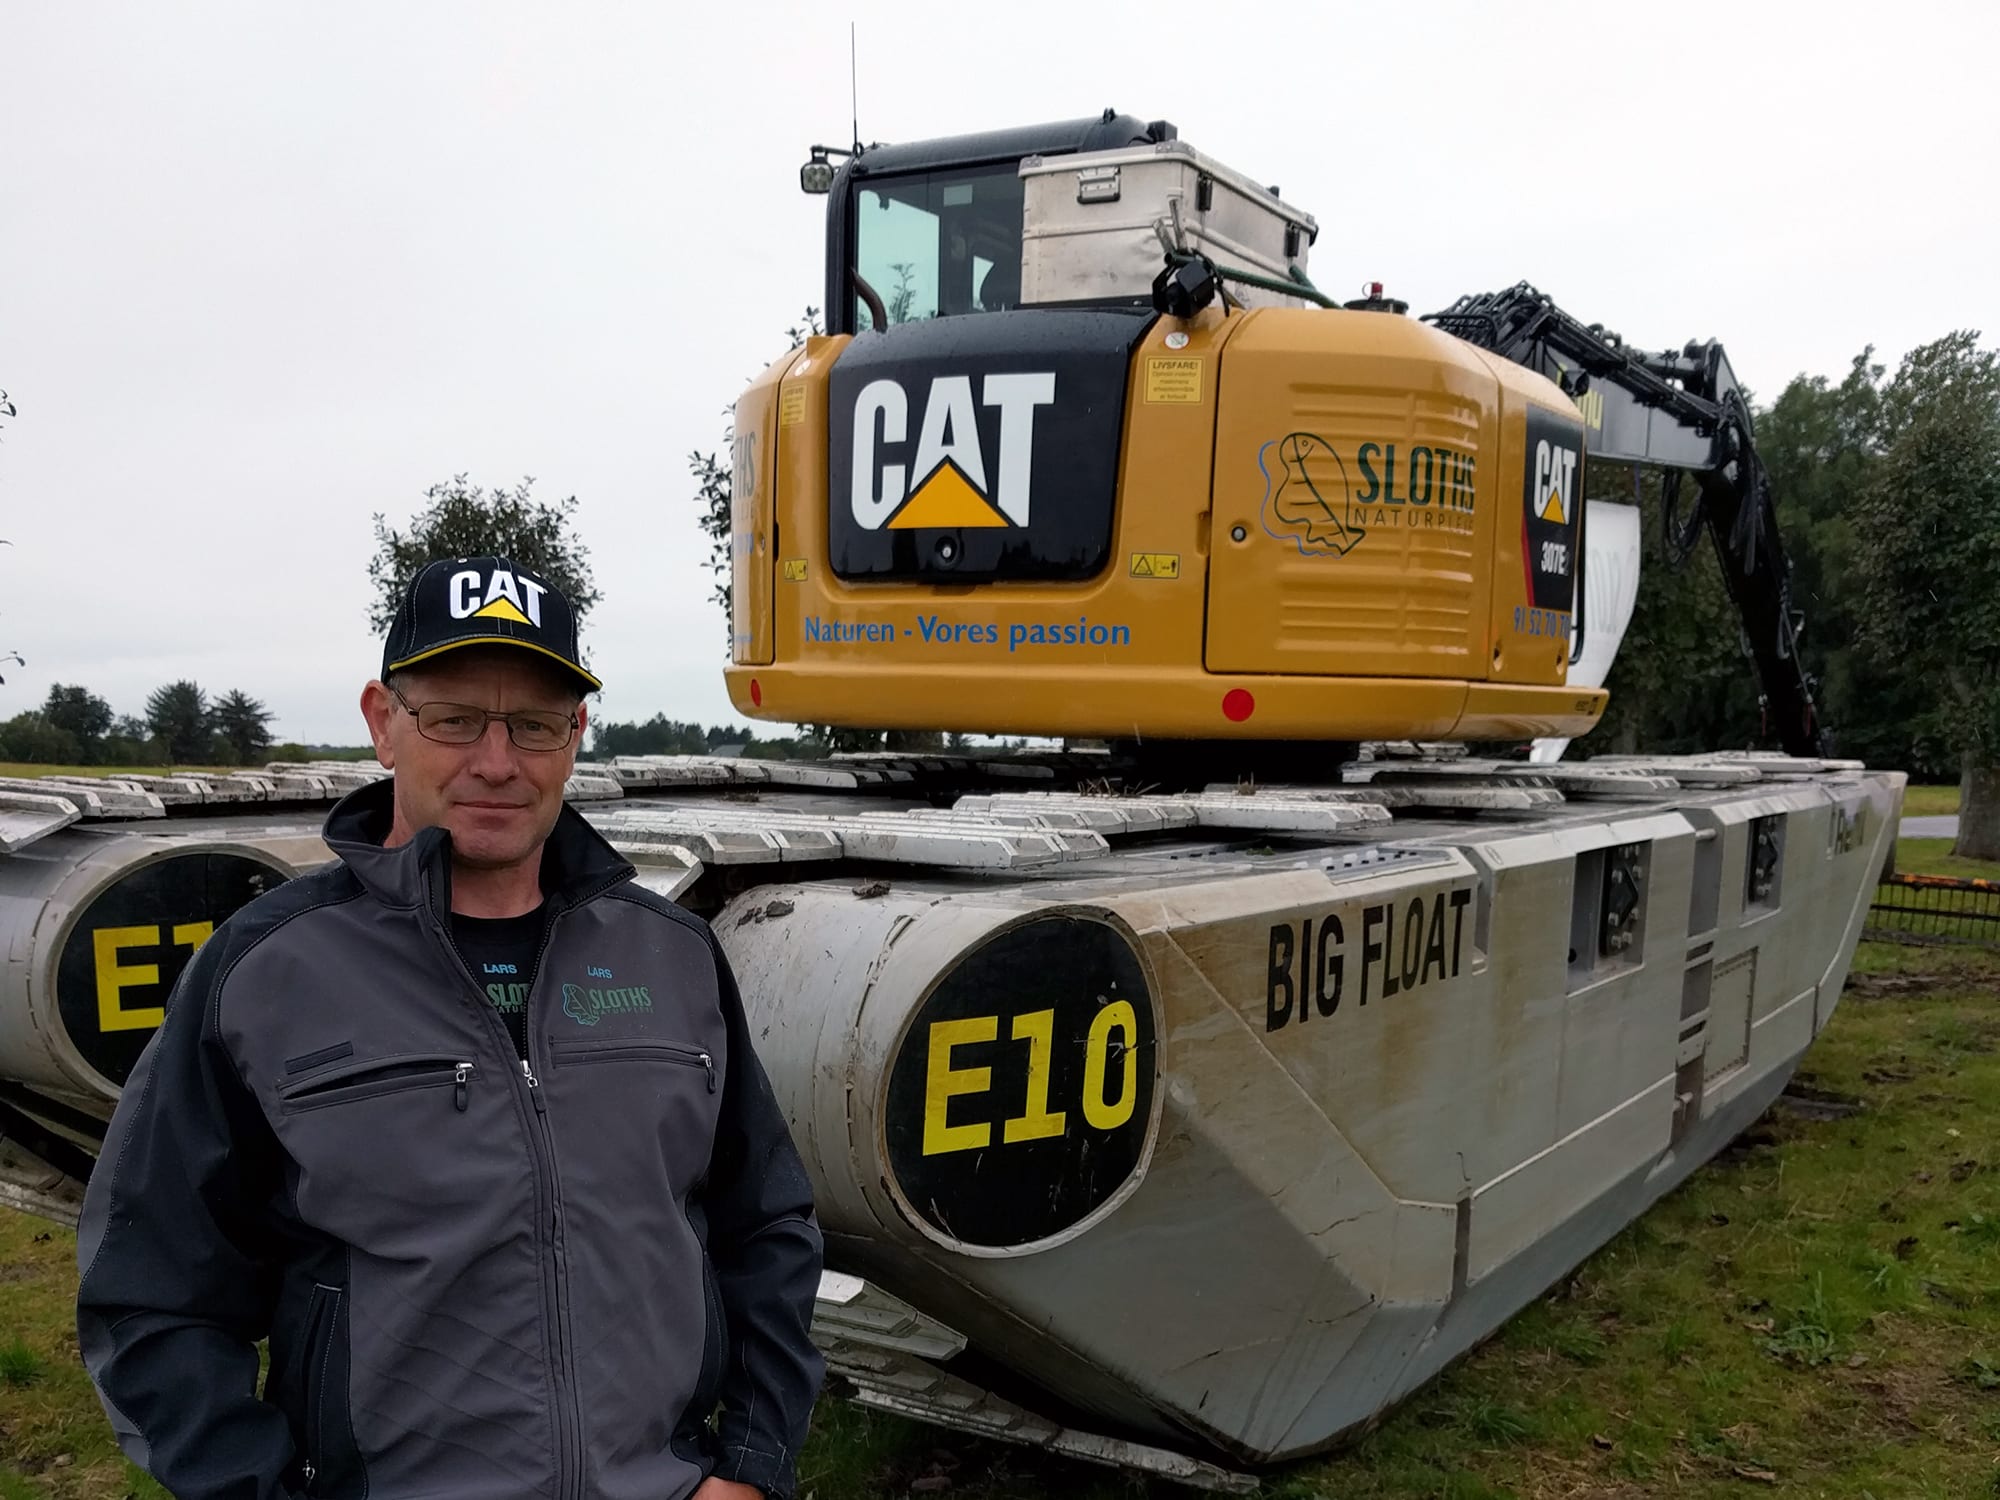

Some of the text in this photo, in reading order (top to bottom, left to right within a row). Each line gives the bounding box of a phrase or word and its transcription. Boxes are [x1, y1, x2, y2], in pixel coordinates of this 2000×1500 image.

[851, 372, 1056, 530] CAT
[1357, 442, 1475, 515] SLOTHS
[1534, 439, 1577, 525] CAT
[450, 569, 549, 629] CAT
[804, 616, 895, 643] Naturen
[916, 615, 999, 644] Vores
[1008, 616, 1131, 653] passion
[483, 963, 518, 975] LARS
[587, 965, 613, 979] LARS
[1265, 888, 1472, 1034] BIG FLOAT
[589, 986, 652, 1010] SLOTHS
[922, 999, 1137, 1156] E10
